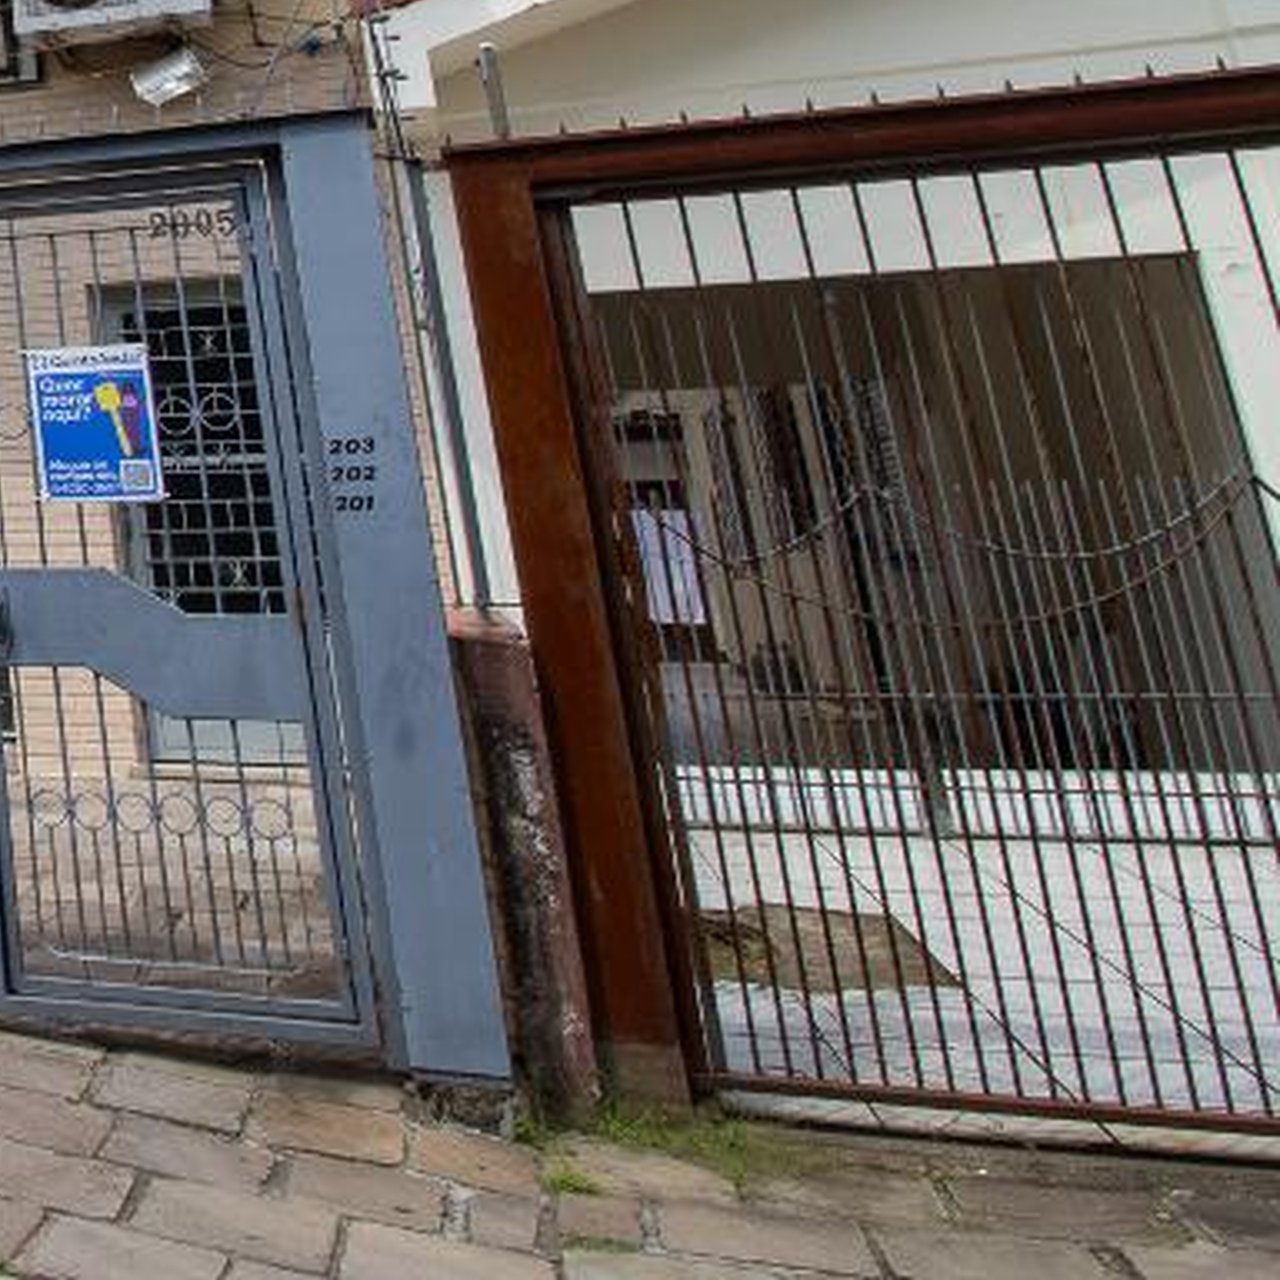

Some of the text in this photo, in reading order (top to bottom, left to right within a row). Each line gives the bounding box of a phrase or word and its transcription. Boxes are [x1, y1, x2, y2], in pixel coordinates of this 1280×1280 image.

[329, 436, 374, 455] 203
[331, 465, 376, 482] 202
[335, 495, 374, 512] 201
